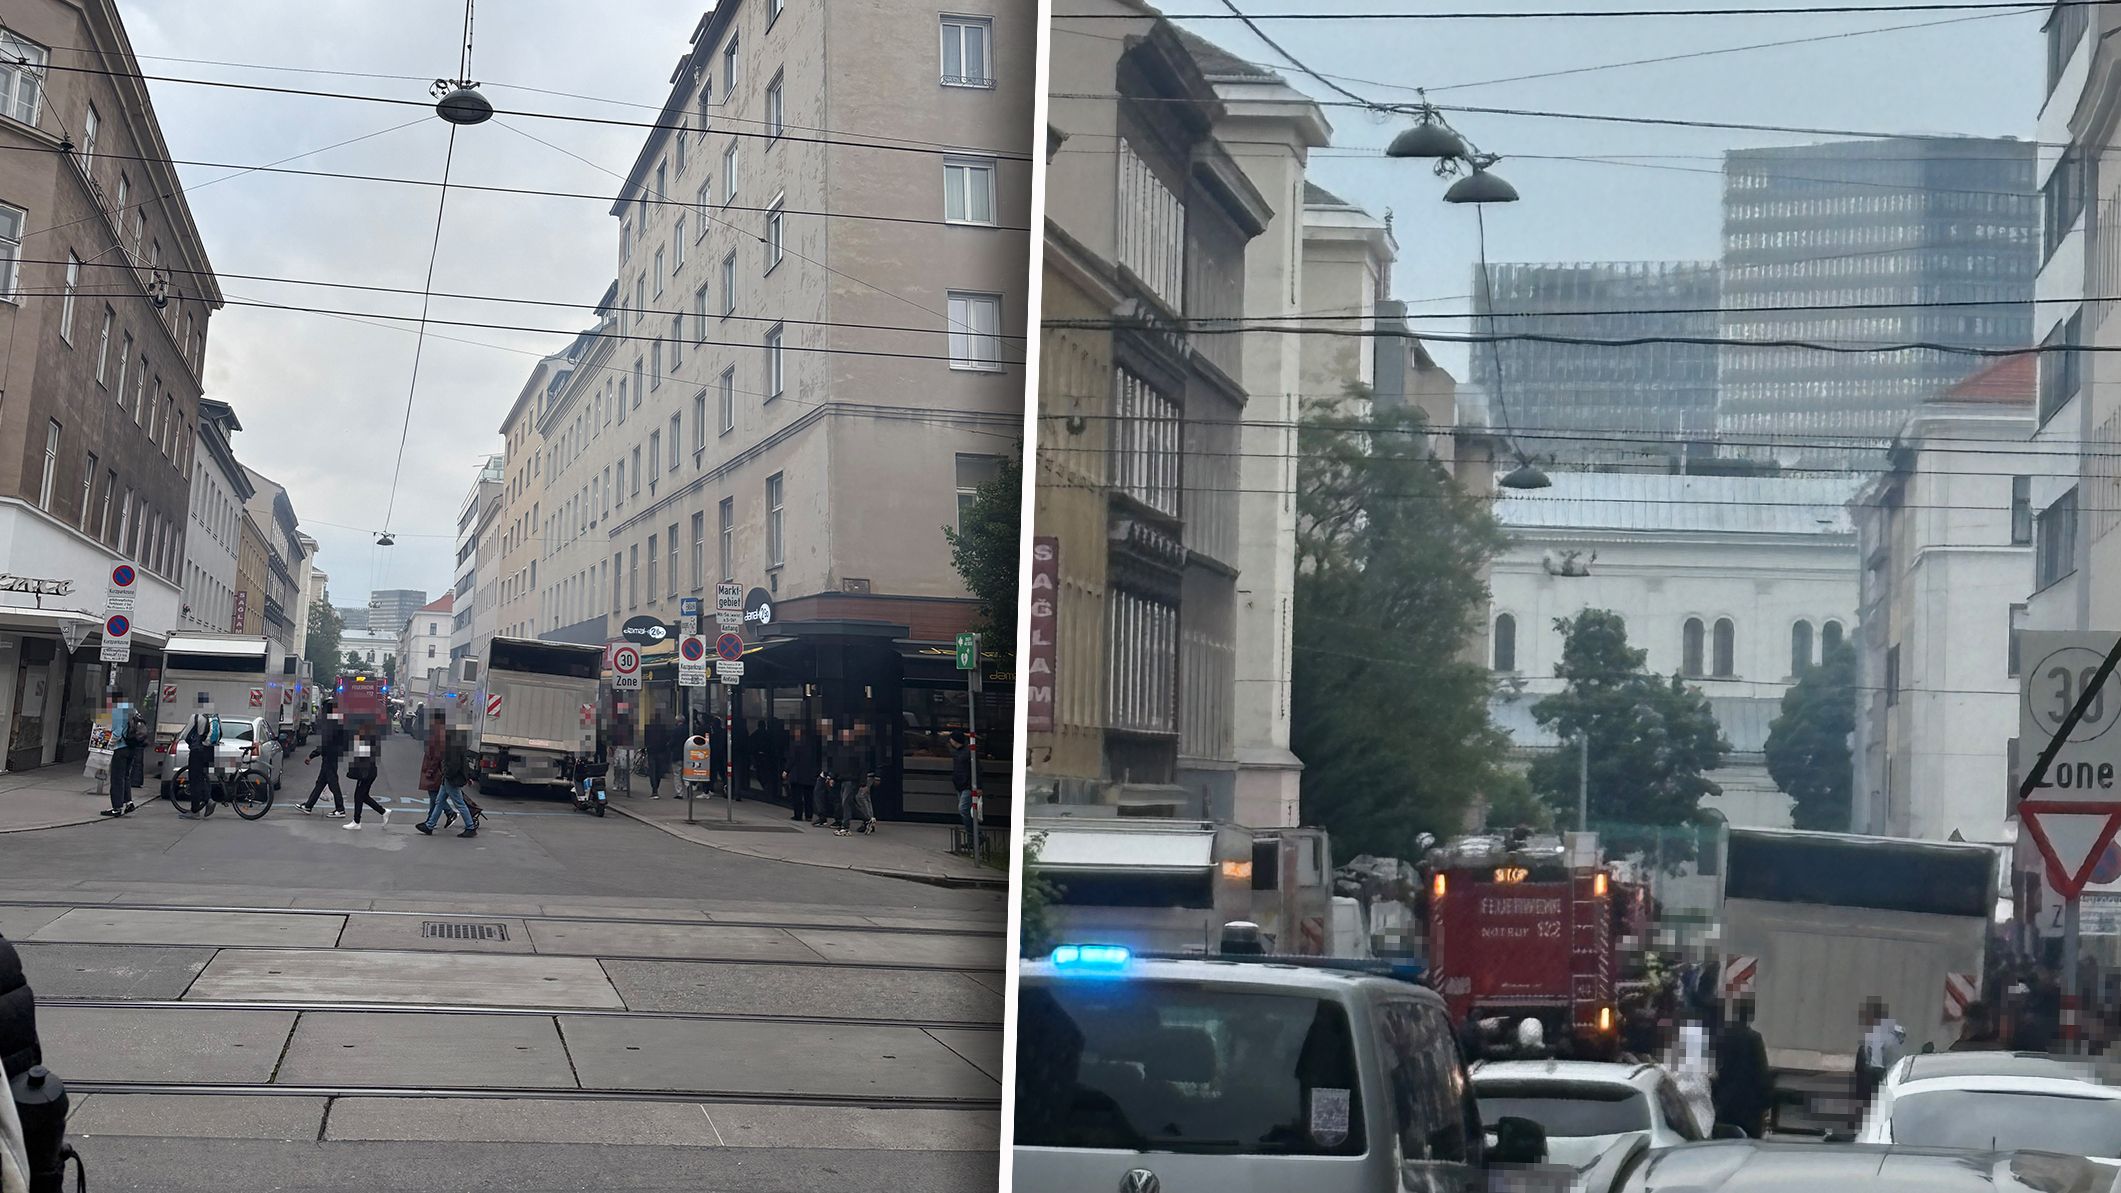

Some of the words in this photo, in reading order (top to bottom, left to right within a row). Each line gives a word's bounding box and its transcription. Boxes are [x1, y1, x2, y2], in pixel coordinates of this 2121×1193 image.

[718, 585, 742, 596] Markt-
[718, 597, 741, 609] gebiet
[620, 654, 633, 667] 30
[616, 675, 638, 687] Zone
[2048, 666, 2104, 723] 30
